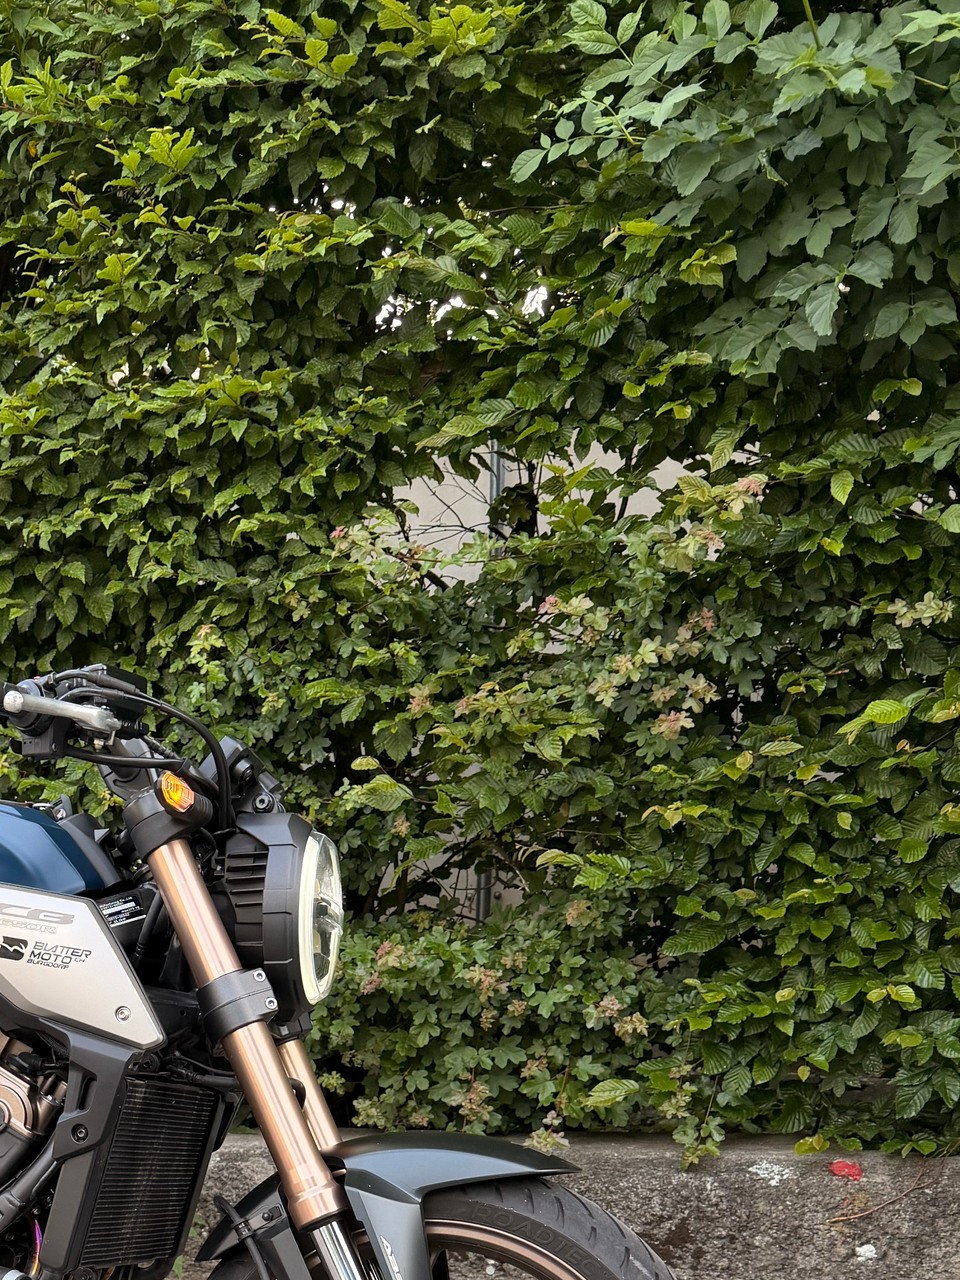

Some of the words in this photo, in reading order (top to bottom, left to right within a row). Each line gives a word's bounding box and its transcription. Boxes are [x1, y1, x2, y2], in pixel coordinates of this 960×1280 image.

[29, 950, 72, 965] MOTO
[33, 941, 92, 958] BLATTER
[27, 958, 70, 969] BURGDORF
[472, 1205, 602, 1276] ROADTEC
